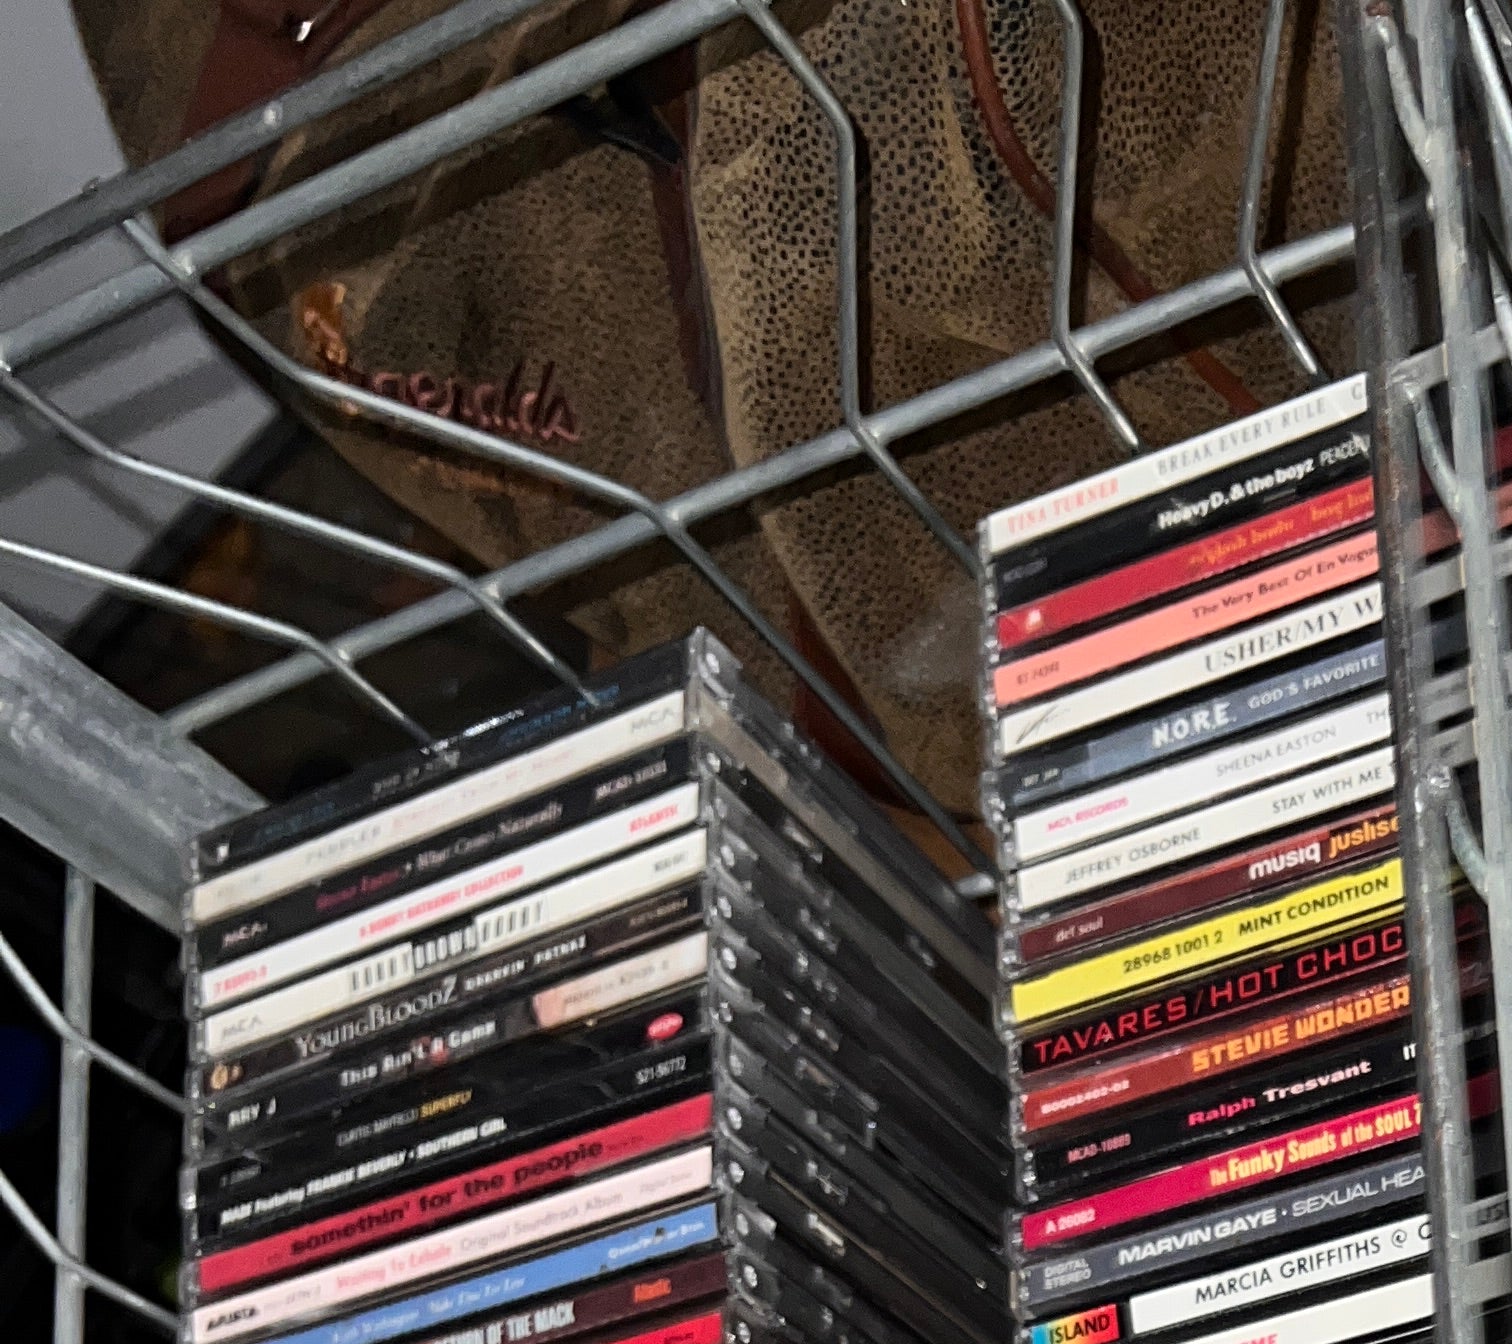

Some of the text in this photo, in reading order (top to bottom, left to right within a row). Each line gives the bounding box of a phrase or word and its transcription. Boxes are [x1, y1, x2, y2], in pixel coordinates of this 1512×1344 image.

[1302, 655, 1380, 692] FAVORITE
[1272, 769, 1383, 813] STAY WITH ME
[1249, 842, 1321, 880] musiq
[1239, 876, 1389, 936] MINT CONDITION
[1192, 985, 1411, 1072] STEVIE WONDER
[1188, 1060, 1372, 1127] Ralph Tresvant
[419, 1191, 458, 1213] for
[464, 1174, 505, 1198] the
[514, 1142, 603, 1184] people
[1049, 1236, 1381, 1344] ISLAND MARCIA GRIFFITHS
[505, 1314, 532, 1341] THE
[534, 1301, 576, 1332] MACK
